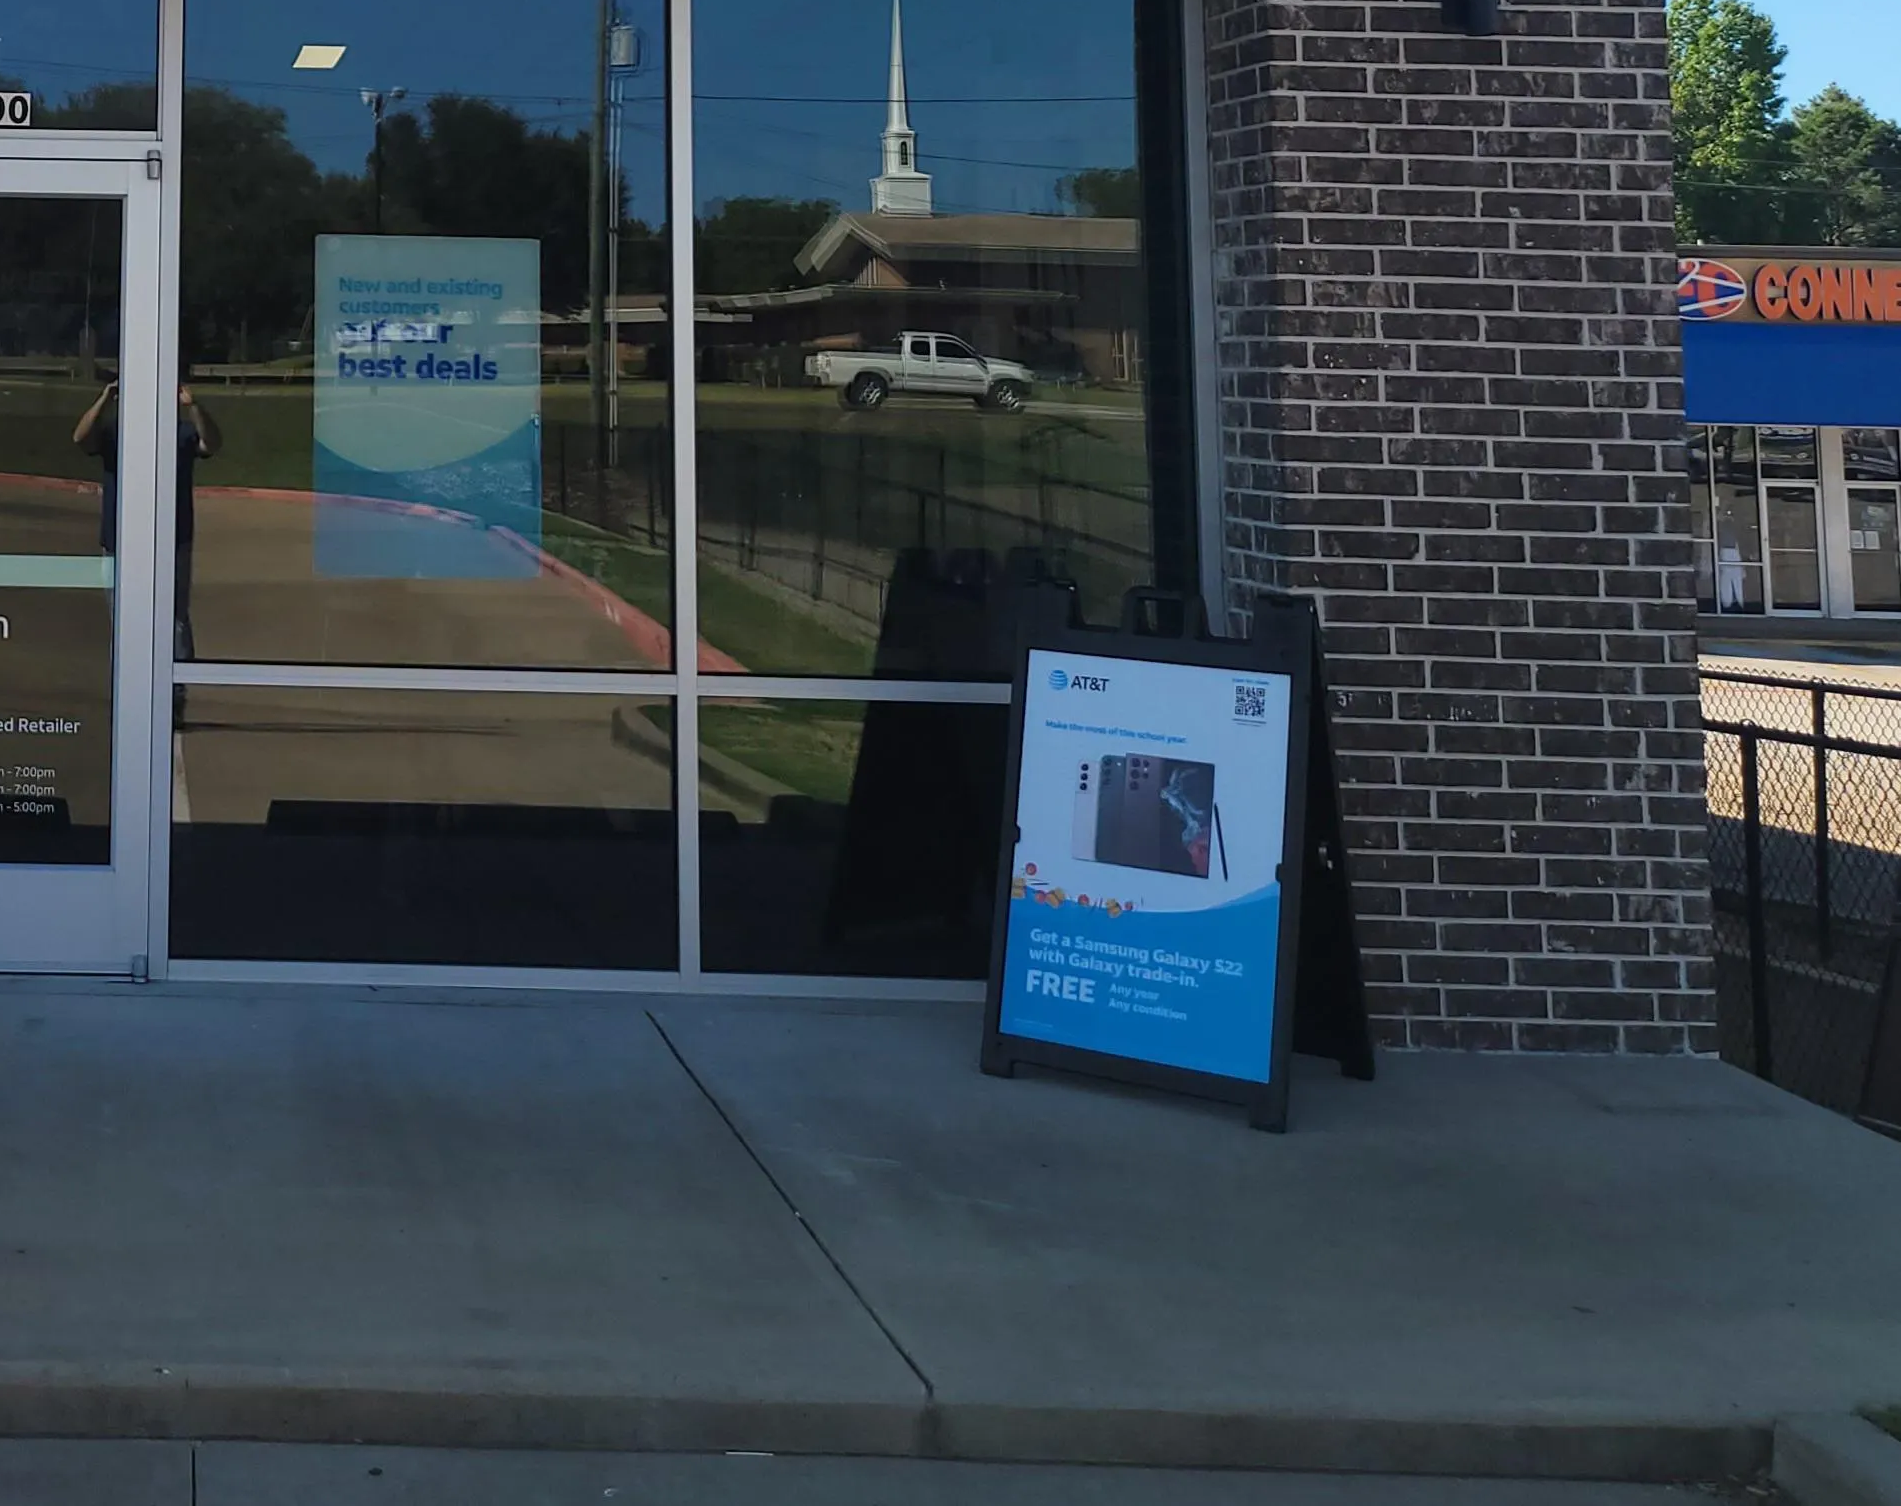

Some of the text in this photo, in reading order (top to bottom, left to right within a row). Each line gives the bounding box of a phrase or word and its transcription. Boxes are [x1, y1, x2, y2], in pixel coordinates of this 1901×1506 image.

[339, 277, 503, 300] New and existing
[339, 299, 440, 315] customers
[338, 352, 499, 381] best deals
[1070, 675, 1110, 693] AT&T
[18, 718, 81, 734] Retailer
[14, 766, 55, 780] 7:00pm
[14, 784, 55, 797] 7:00pm
[13, 801, 55, 814] 5:00pm
[1030, 928, 1244, 977] Get a Samsung Galaxy S22
[1029, 946, 1200, 989] with Galaxy trade-in.
[1026, 968, 1097, 1004] FREE
[1108, 983, 1161, 1002] Any year
[1108, 999, 1188, 1022] Any condition
